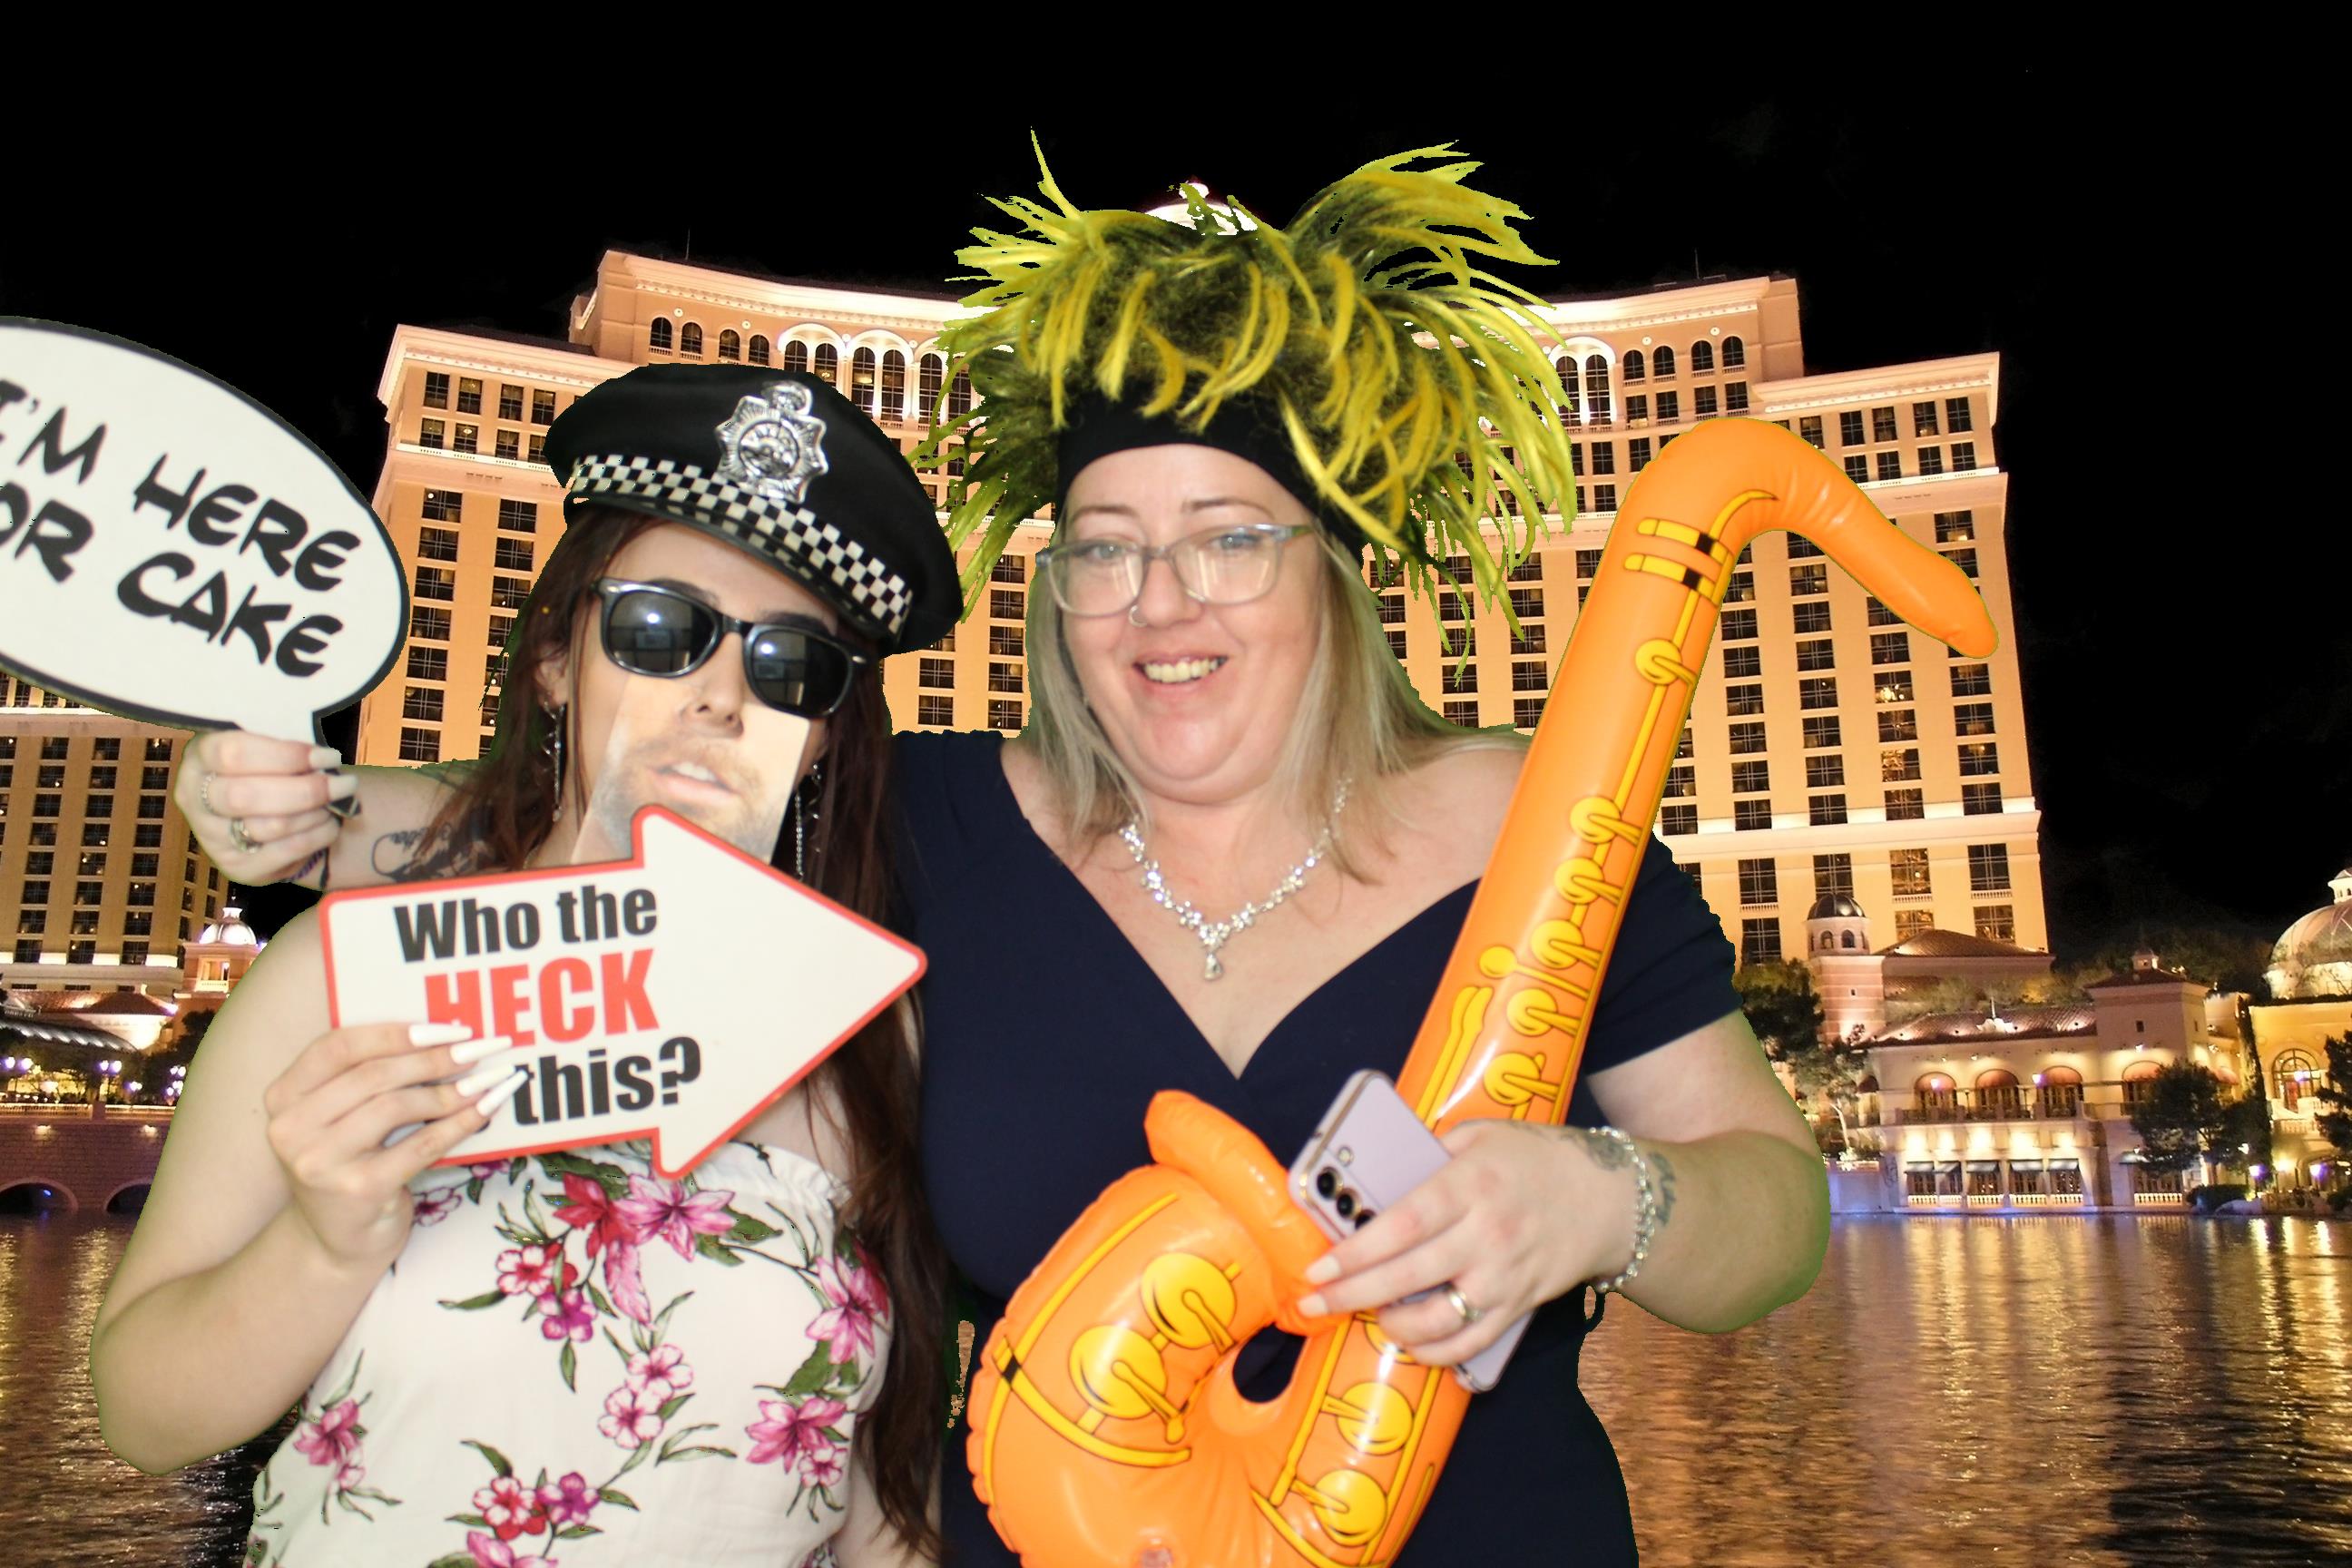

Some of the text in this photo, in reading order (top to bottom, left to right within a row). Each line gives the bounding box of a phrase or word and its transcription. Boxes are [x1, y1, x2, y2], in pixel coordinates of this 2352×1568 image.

[132, 453, 362, 592] HERE
[116, 551, 344, 678] CAKE
[393, 885, 658, 963] Who the
[425, 948, 660, 1048] HECK
[513, 1036, 701, 1126] this?
